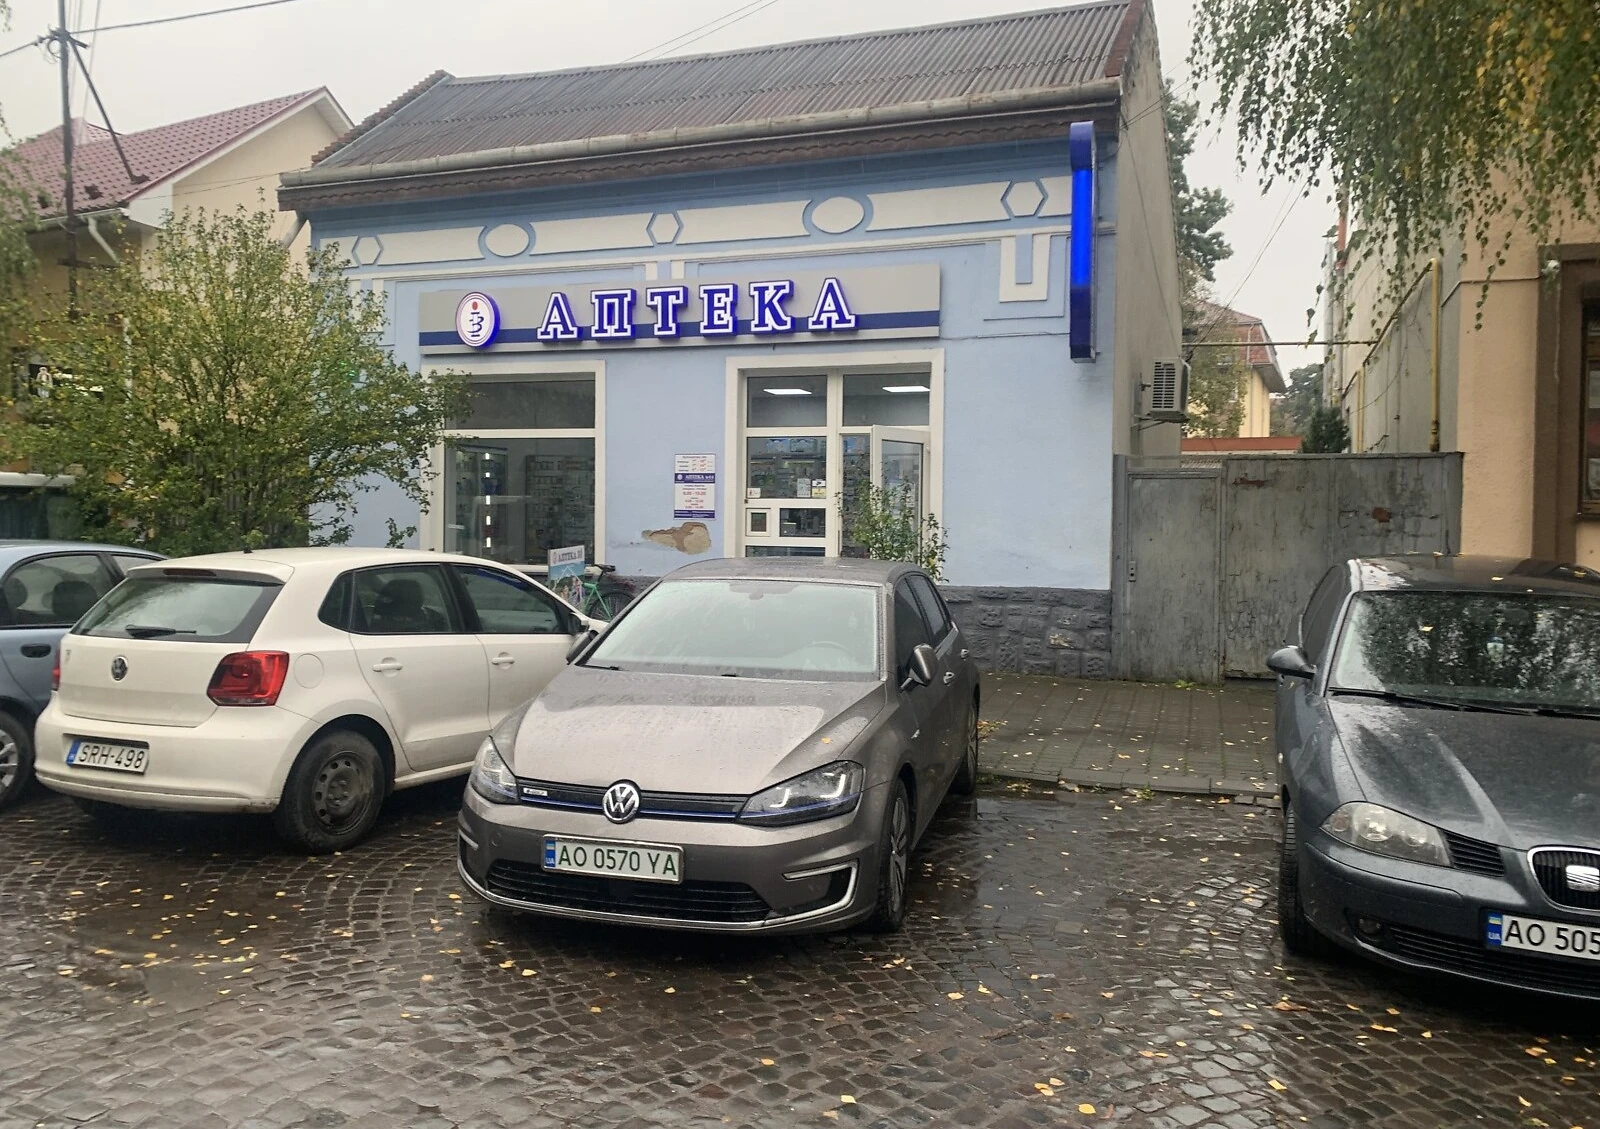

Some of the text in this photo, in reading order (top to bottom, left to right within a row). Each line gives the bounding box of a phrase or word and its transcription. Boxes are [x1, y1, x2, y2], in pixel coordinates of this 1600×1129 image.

[537, 278, 857, 342] АПТЕКА
[79, 744, 145, 769] SRH-498
[558, 845, 677, 875] AO 0570 YA
[1504, 919, 1545, 946] AO
